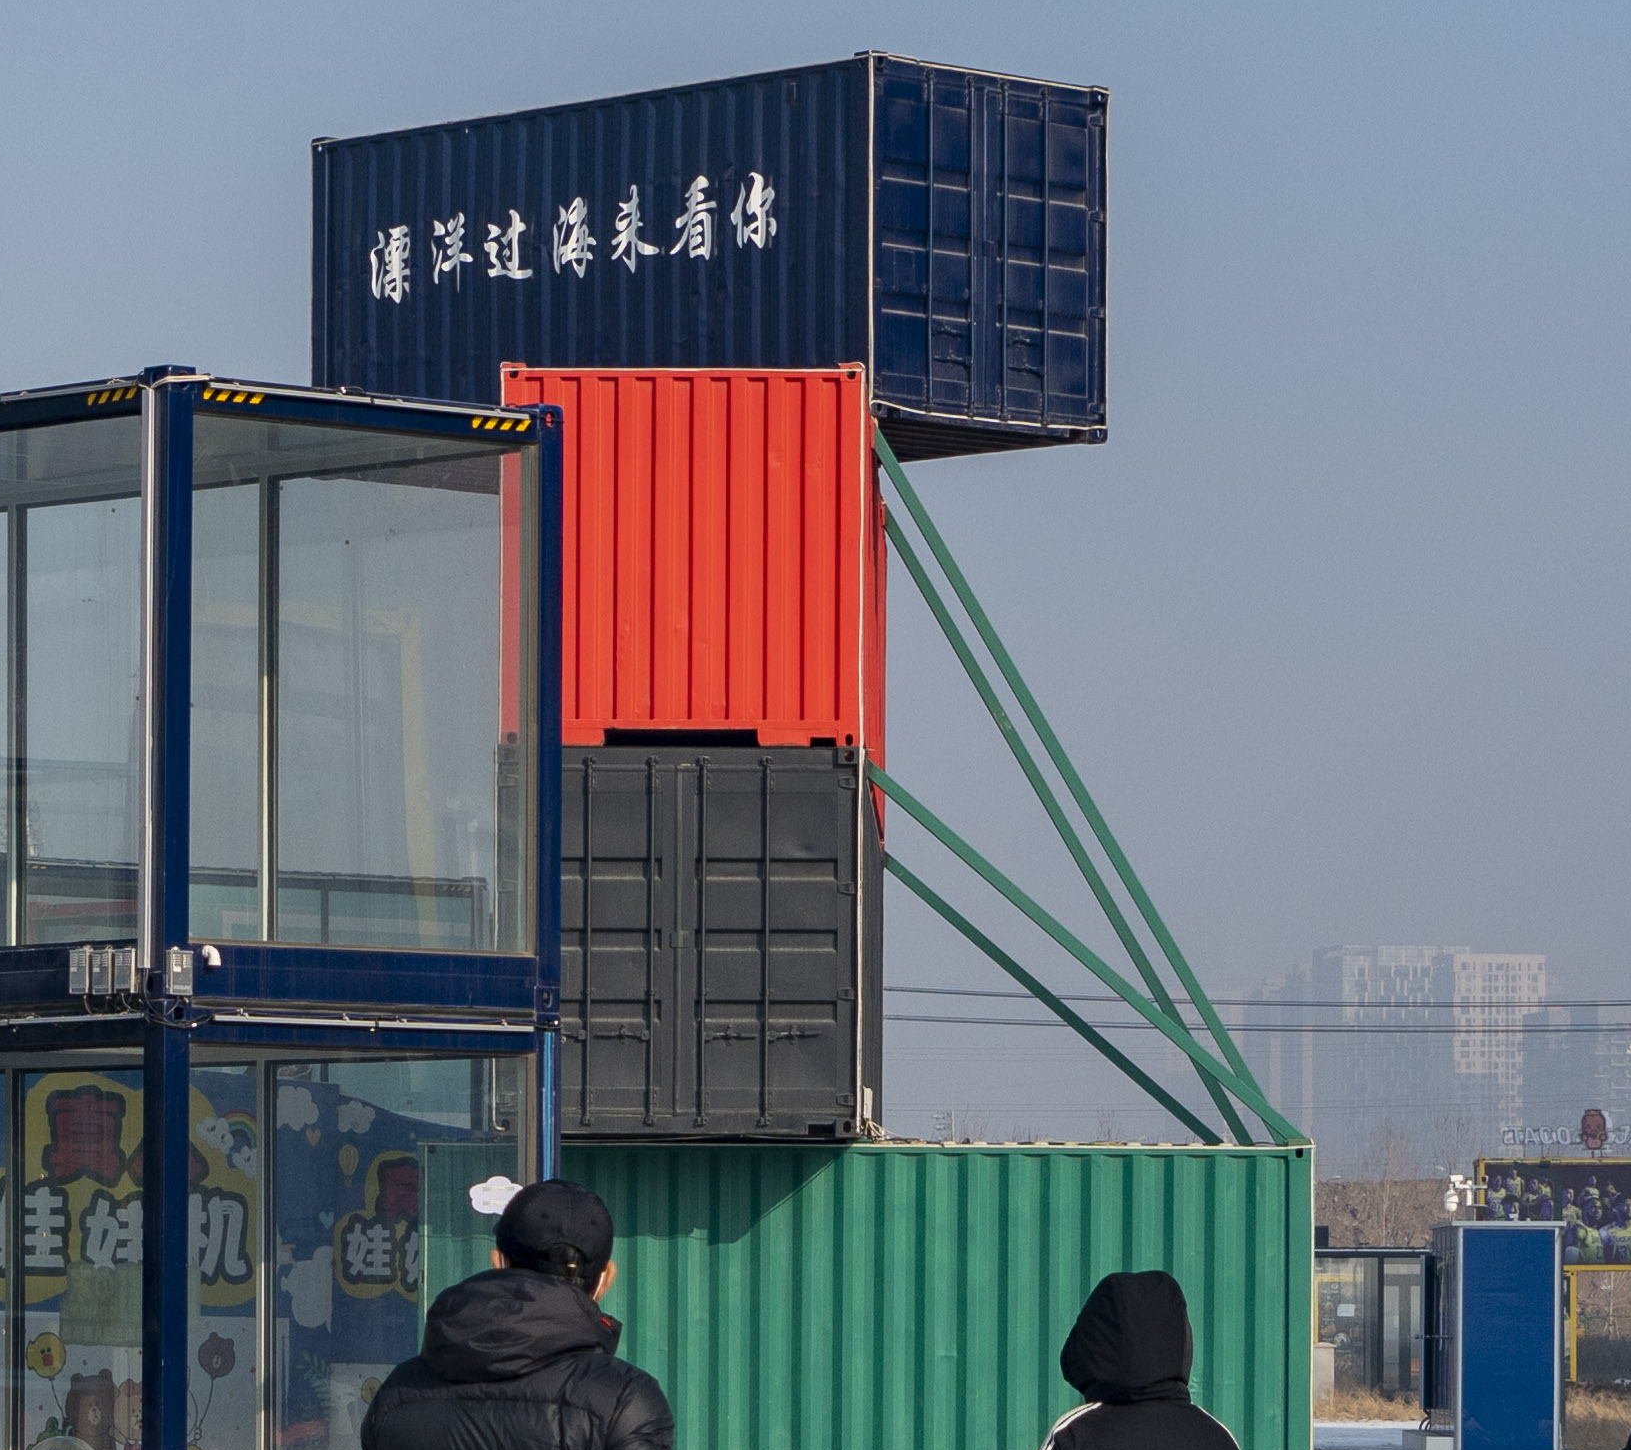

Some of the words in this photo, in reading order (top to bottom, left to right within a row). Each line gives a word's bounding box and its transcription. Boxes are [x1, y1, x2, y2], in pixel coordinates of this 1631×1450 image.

[369, 171, 778, 304] 漂洋过海来看你
